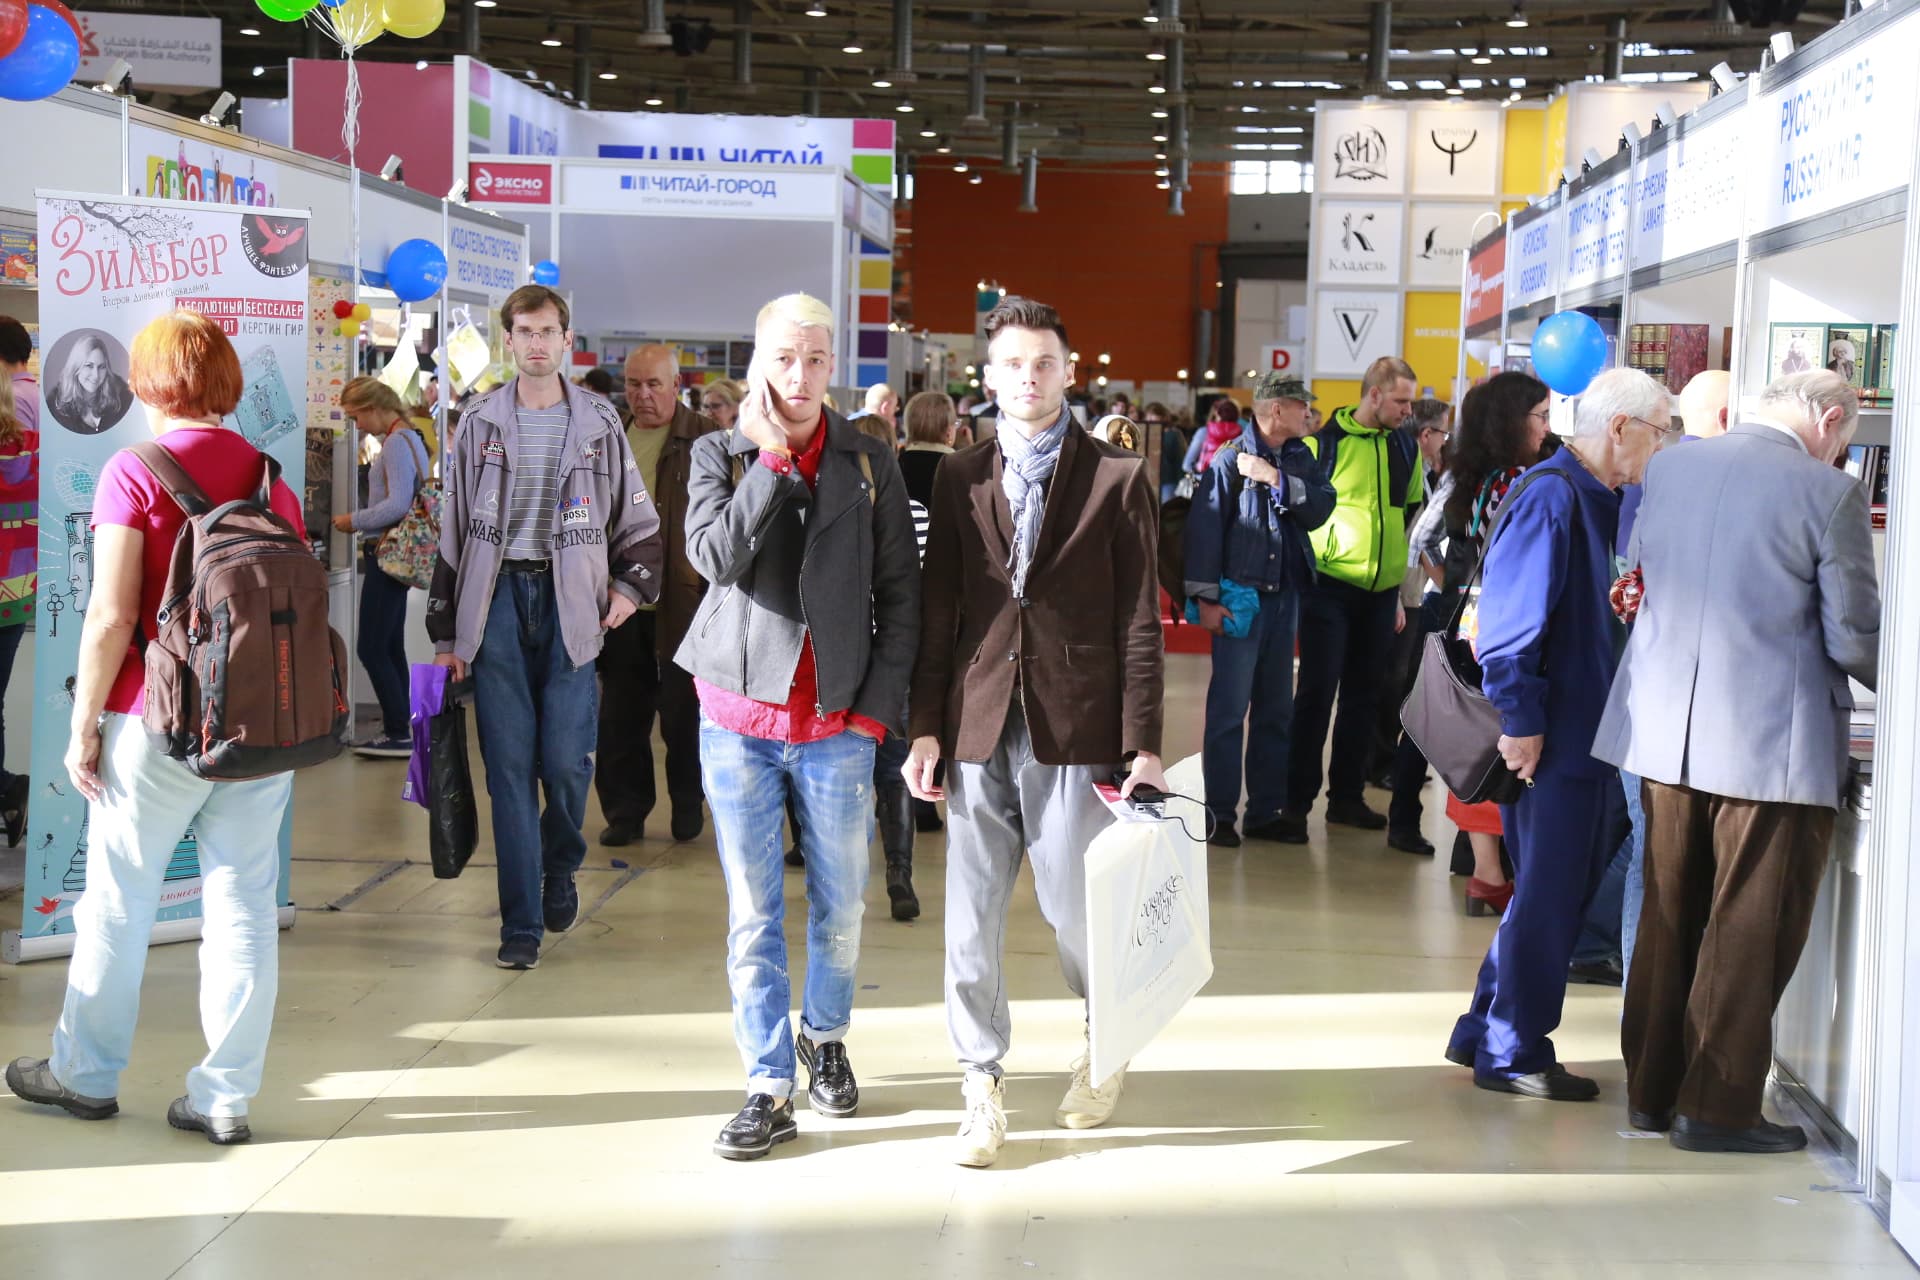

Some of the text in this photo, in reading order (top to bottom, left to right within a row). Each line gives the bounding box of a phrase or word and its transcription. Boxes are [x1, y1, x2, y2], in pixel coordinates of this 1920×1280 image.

[141, 49, 164, 60] Book
[1837, 133, 1862, 187] MIR
[494, 177, 543, 190] ЭКСМО
[652, 174, 777, 197] ЧИТАЙ-ГОРОД
[241, 226, 299, 276] ЛУЧШЕЕ ФЭНТЕЗИ
[457, 259, 477, 283] RECH
[477, 263, 515, 291] PUBLISHERS
[177, 299, 304, 317] АБСОЛЮТНЫЙ БЕСТСЕЛЛЕР
[223, 320, 304, 337] ОТ КЕРСТИН ГИР
[1272, 349, 1291, 370] D
[563, 509, 588, 522] BOSS
[469, 518, 603, 550] WARS TEINER
[279, 639, 289, 711] Hedgren
